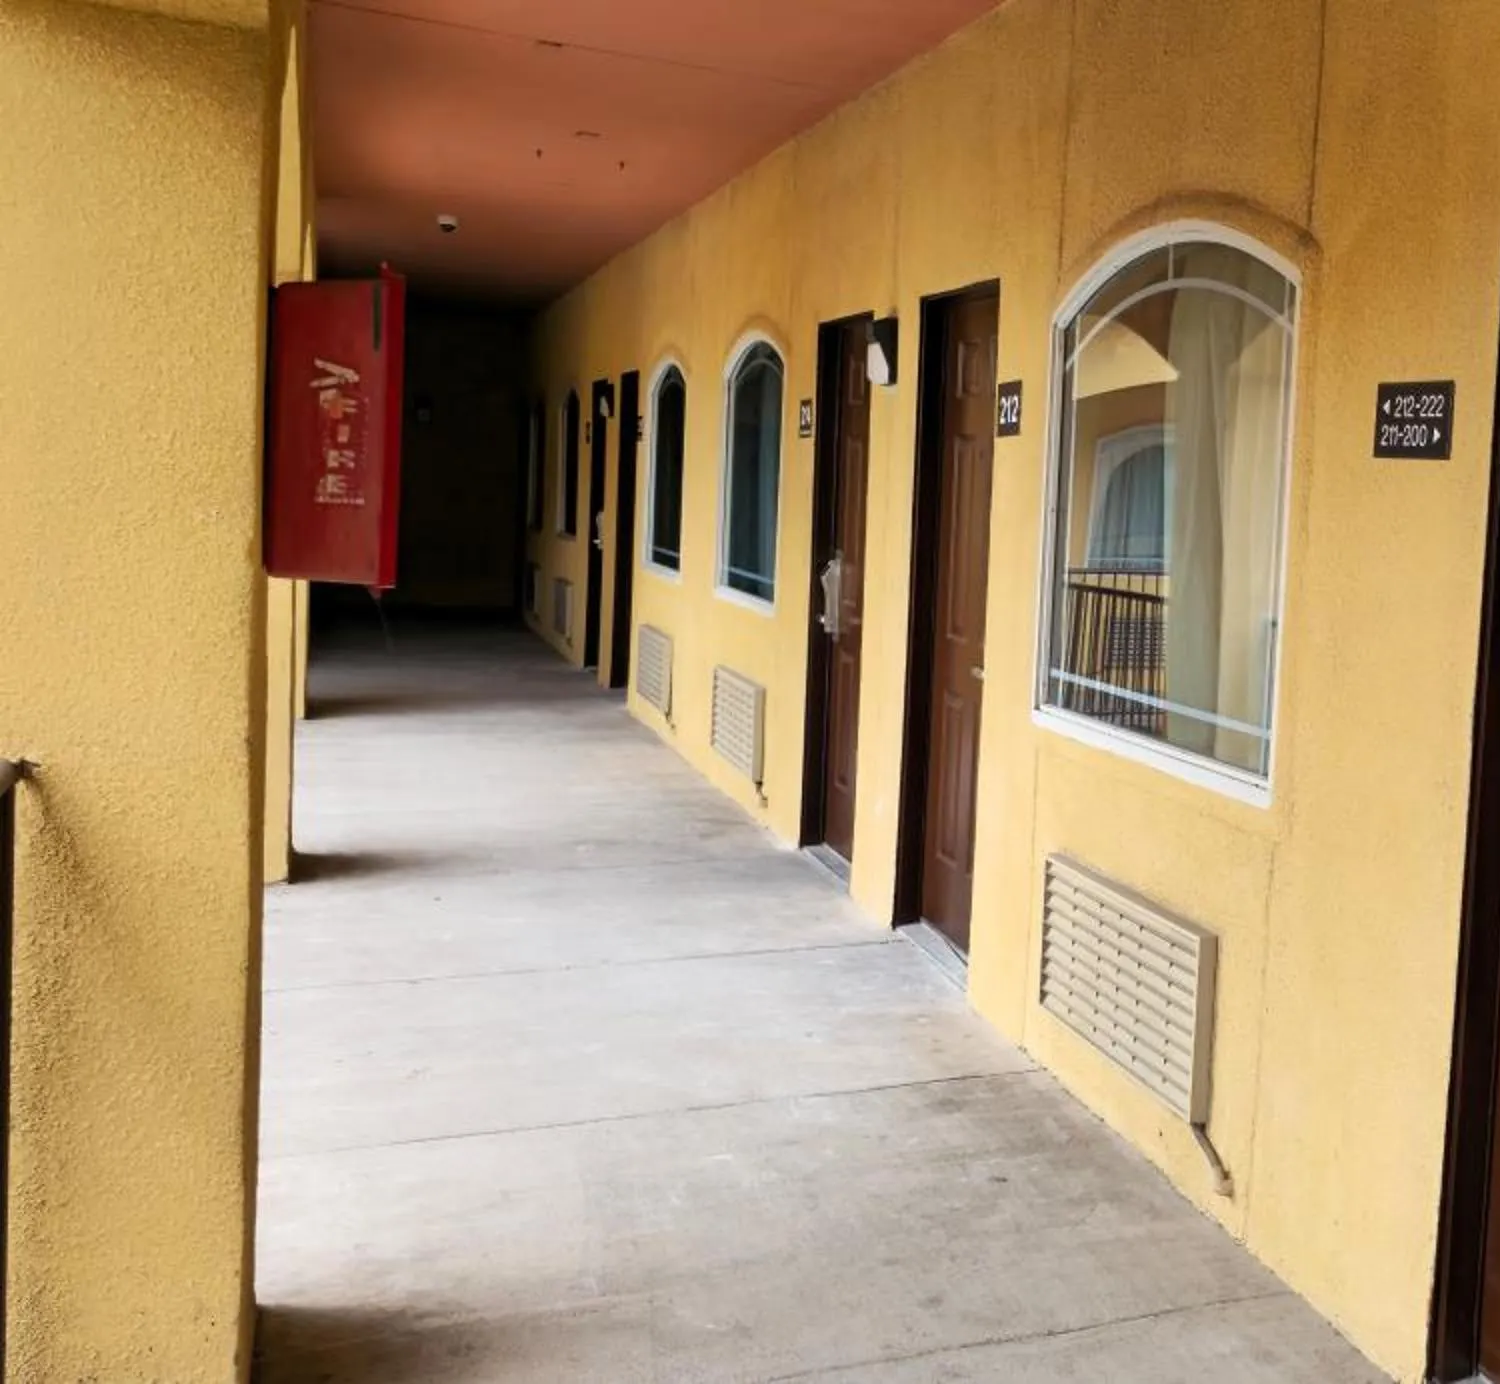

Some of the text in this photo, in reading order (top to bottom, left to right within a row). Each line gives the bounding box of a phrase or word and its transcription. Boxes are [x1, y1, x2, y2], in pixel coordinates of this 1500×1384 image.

[1000, 395, 1019, 424] 212
[1394, 394, 1445, 417] 212-222
[1380, 424, 1428, 446] 211-200
